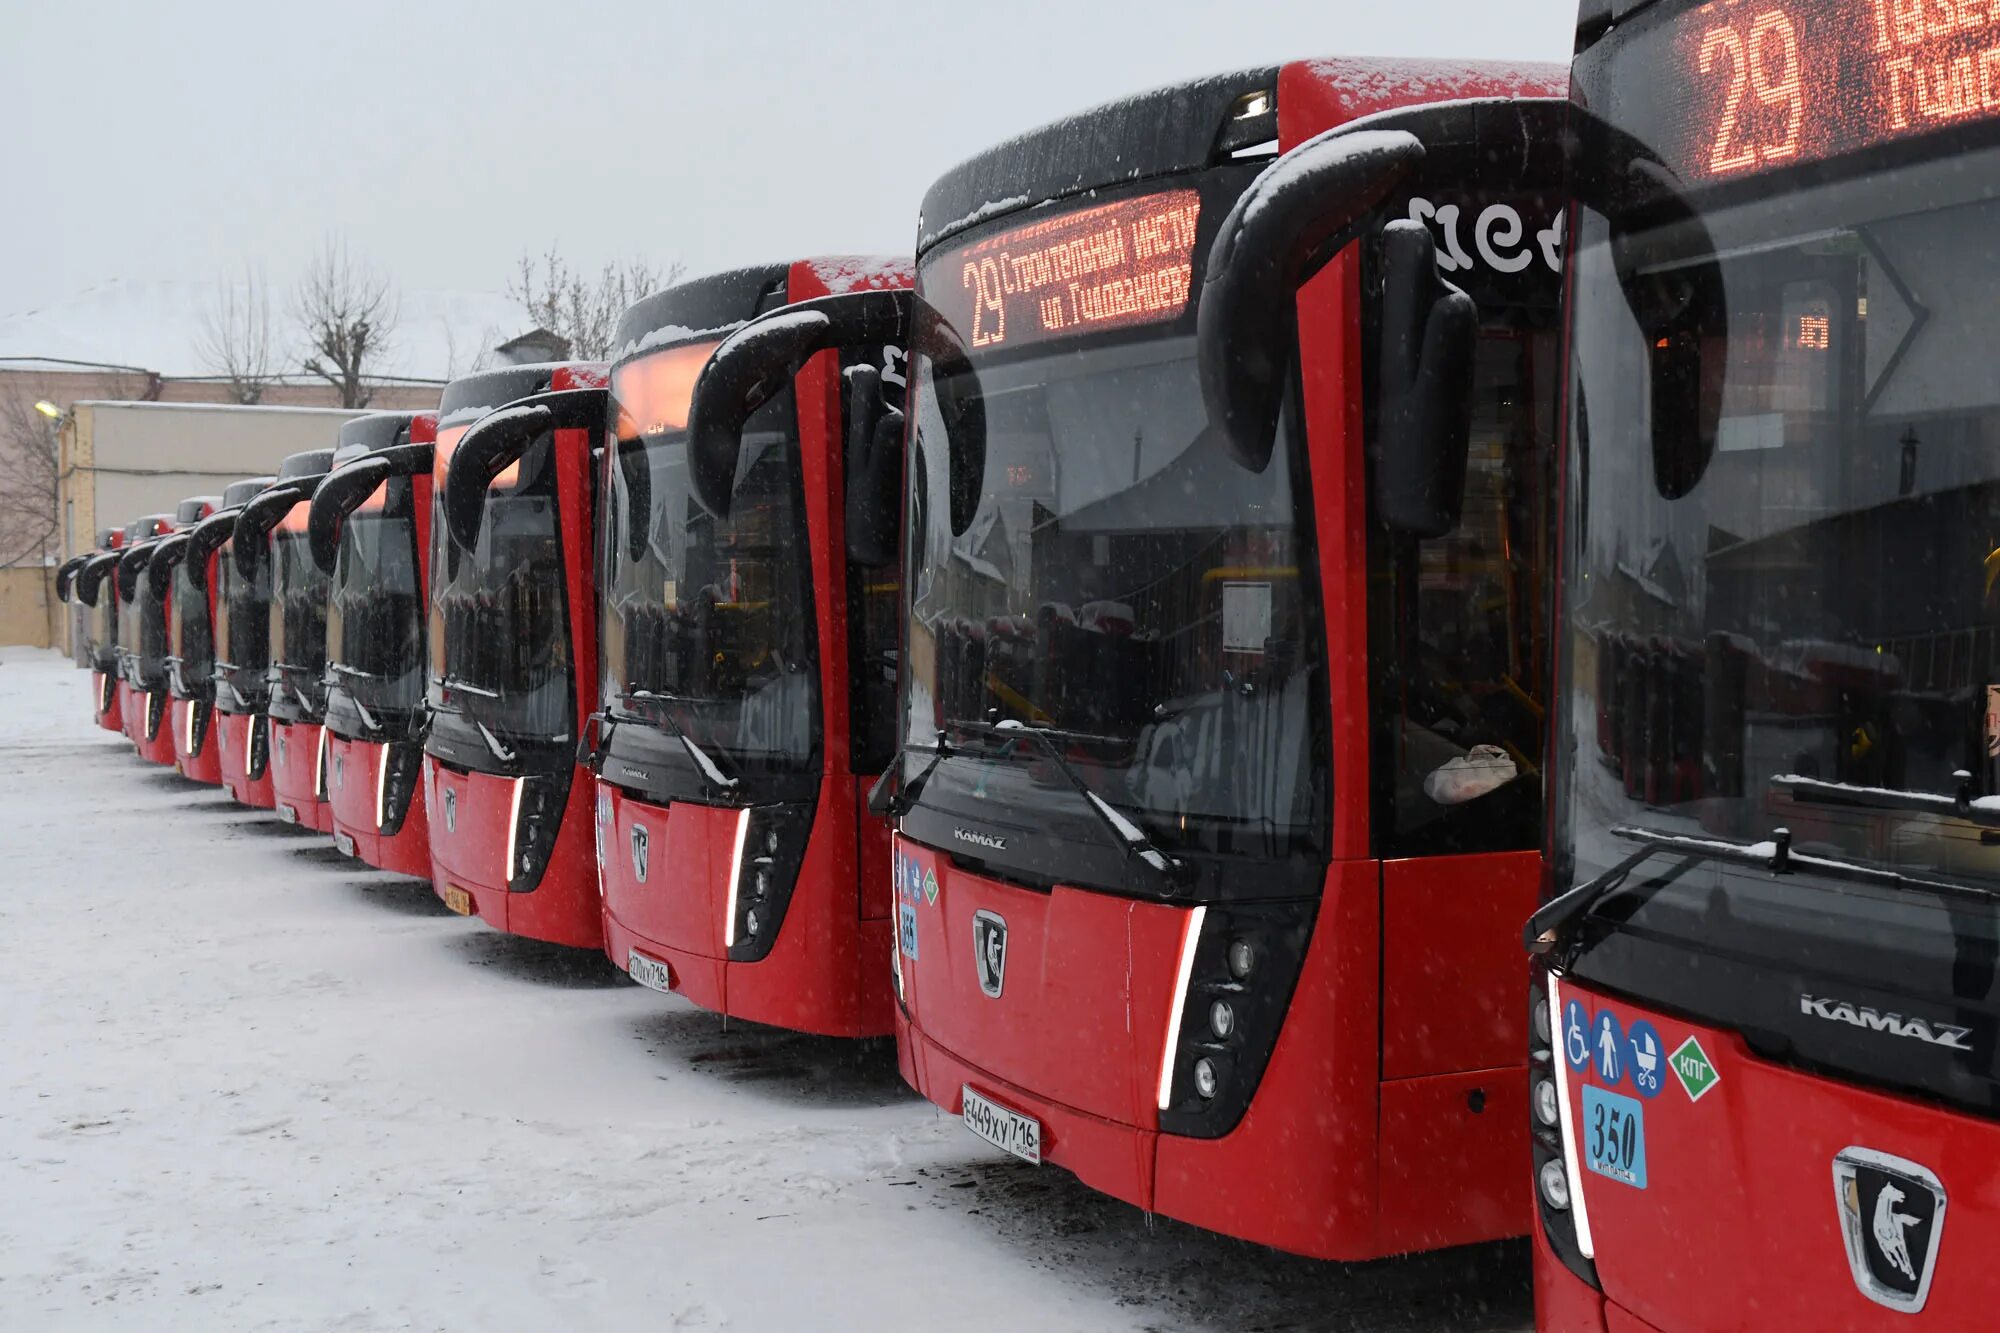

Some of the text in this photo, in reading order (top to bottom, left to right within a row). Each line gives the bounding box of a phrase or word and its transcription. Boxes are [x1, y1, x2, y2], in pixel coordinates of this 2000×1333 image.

[1699, 10, 1802, 172] 29
[1000, 219, 1125, 294] Строительный
[963, 256, 1004, 346] 29
[954, 827, 1006, 850] KAMAZ
[650, 963, 665, 983] 716
[1800, 993, 1974, 1051] KAMAZ
[1680, 1054, 1708, 1081] КПГ
[1016, 1143, 1029, 1156] RUS
[1592, 1103, 1636, 1170] 350
